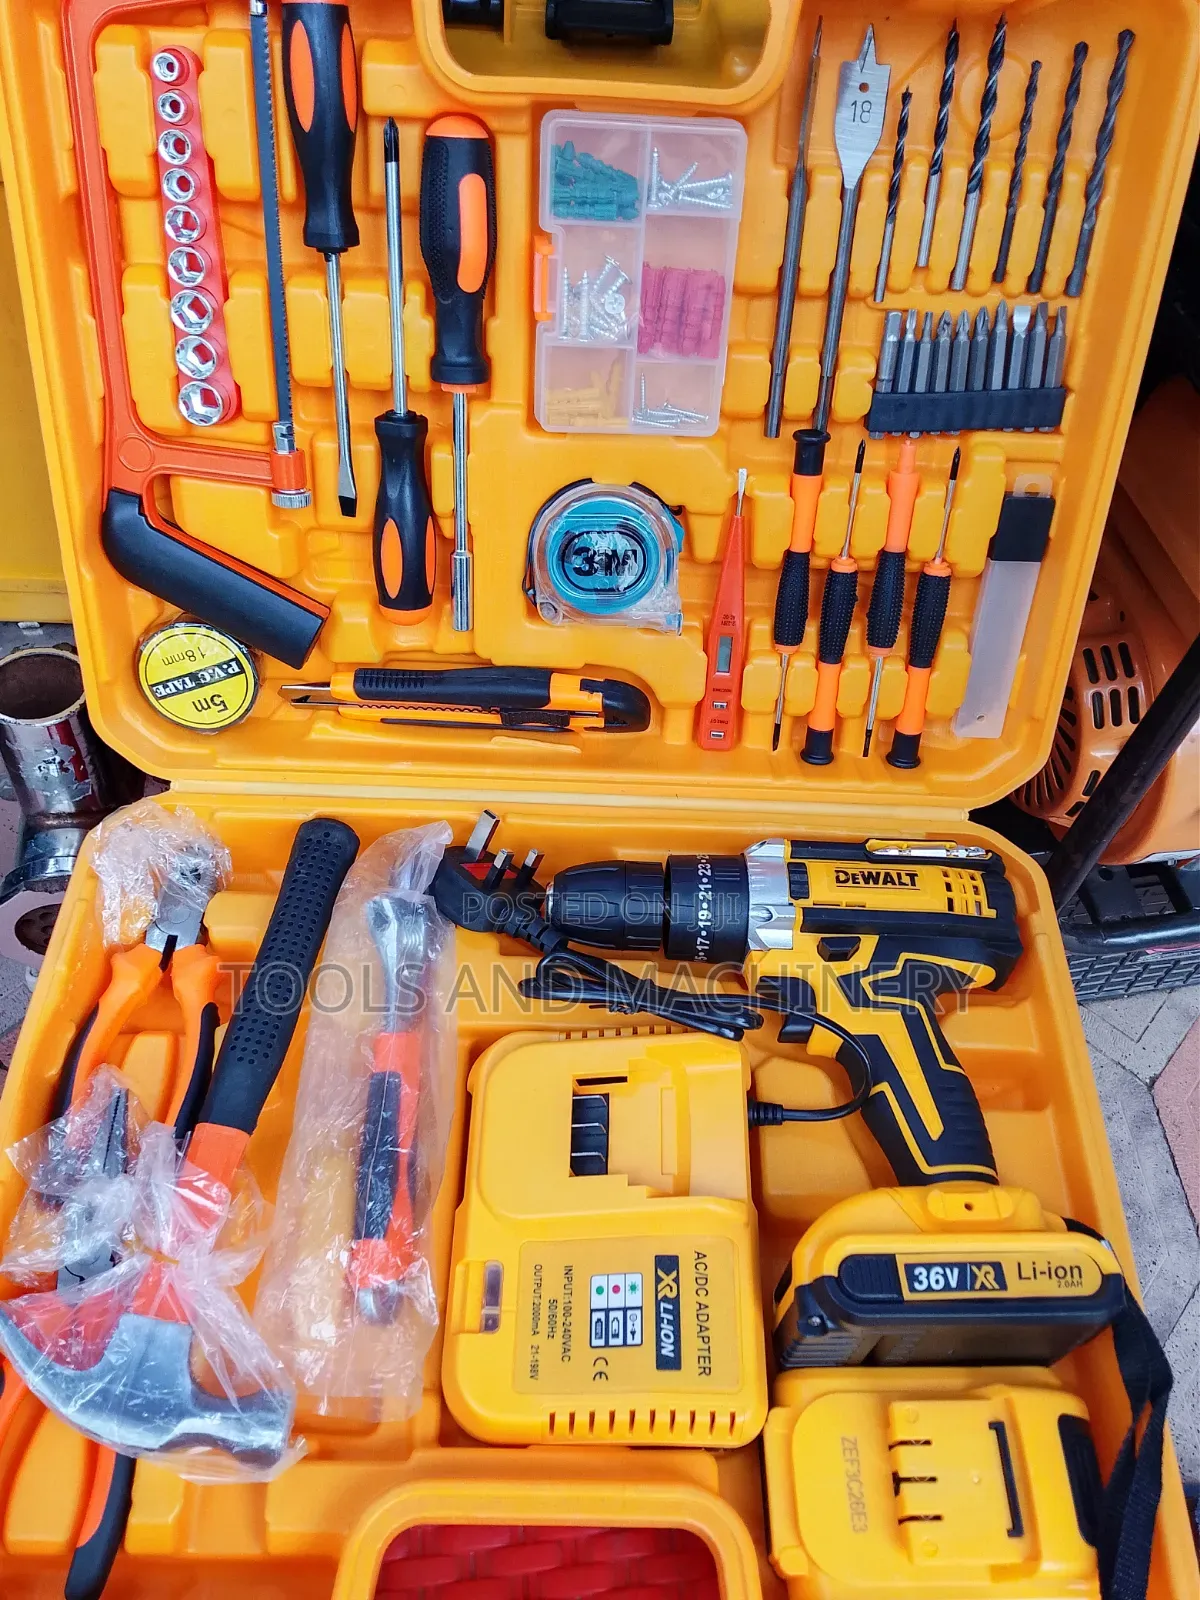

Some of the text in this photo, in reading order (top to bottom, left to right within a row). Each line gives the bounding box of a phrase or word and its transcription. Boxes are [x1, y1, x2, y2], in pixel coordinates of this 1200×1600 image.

[850, 99, 873, 124] 18
[161, 646, 207, 666] 18mm
[152, 676, 196, 698] TAPE
[191, 693, 229, 713] 5m
[913, 1264, 1000, 1291] 36V XR
[1017, 1261, 1083, 1281] Li-ion
[547, 1298, 558, 1340] 50/60Hz
[657, 1268, 678, 1357] XR LI-ION
[694, 1250, 711, 1377] AC/DC ADAPTER
